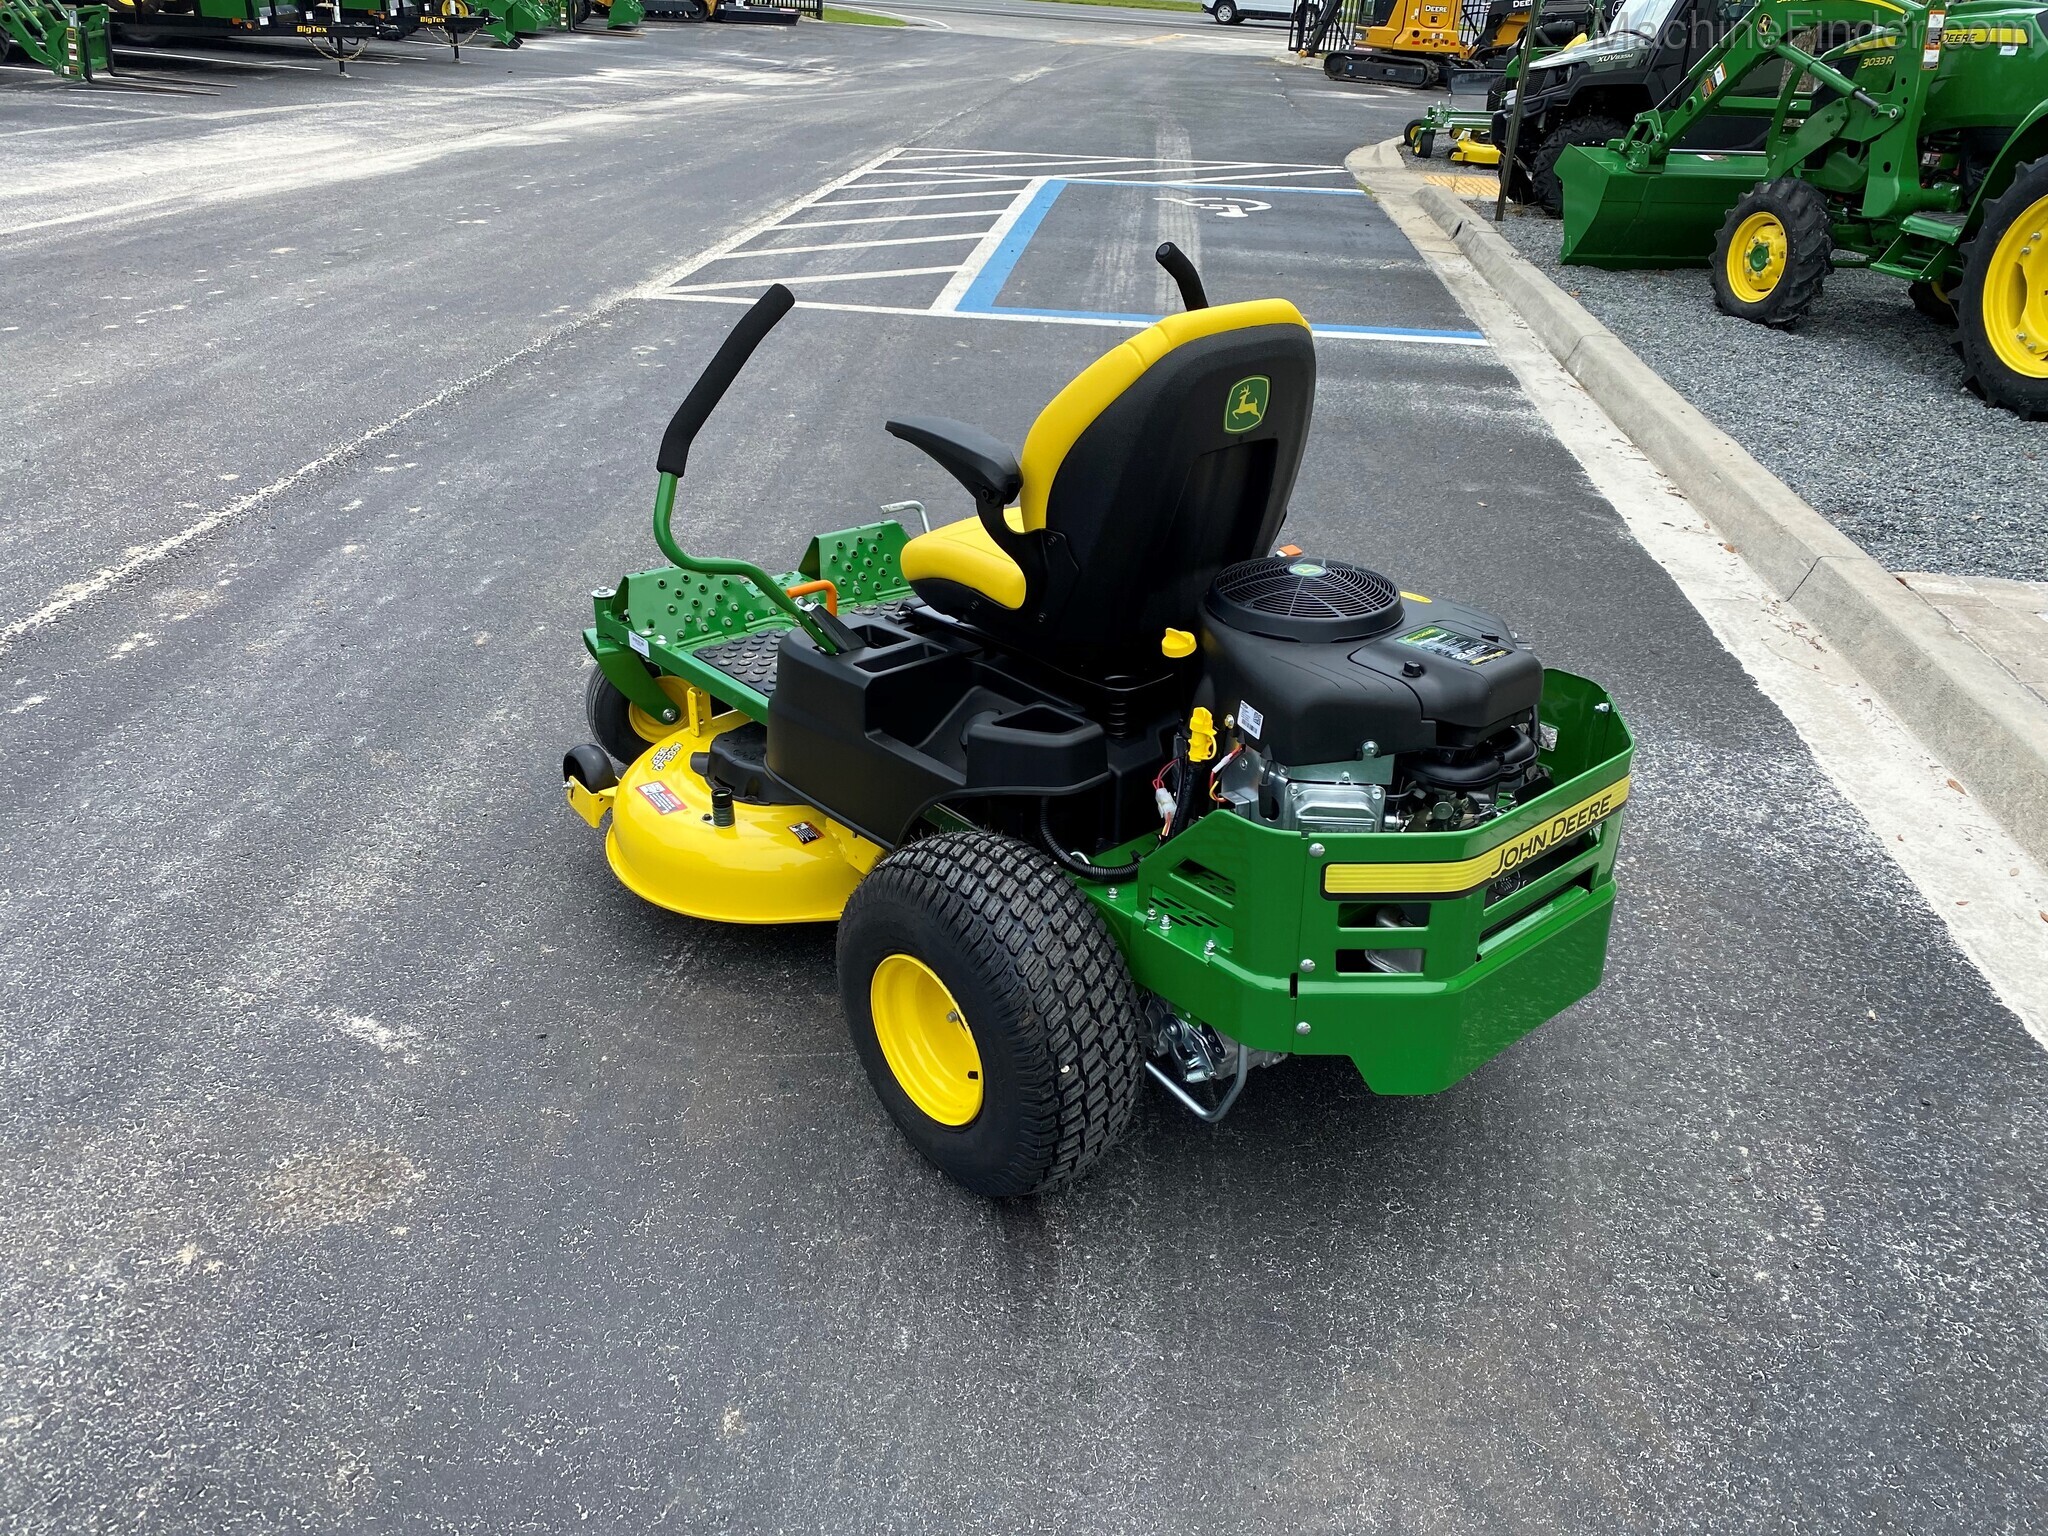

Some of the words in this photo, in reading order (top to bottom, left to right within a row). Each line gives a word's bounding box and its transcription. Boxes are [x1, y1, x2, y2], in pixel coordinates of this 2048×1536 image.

[1512, 0, 1533, 8] DEE
[1425, 5, 1448, 13] DEERE
[420, 16, 446, 24] BigTex
[296, 25, 328, 34] BigTex
[1490, 829, 1548, 877] JOHN
[1550, 793, 1613, 845] DEERE
